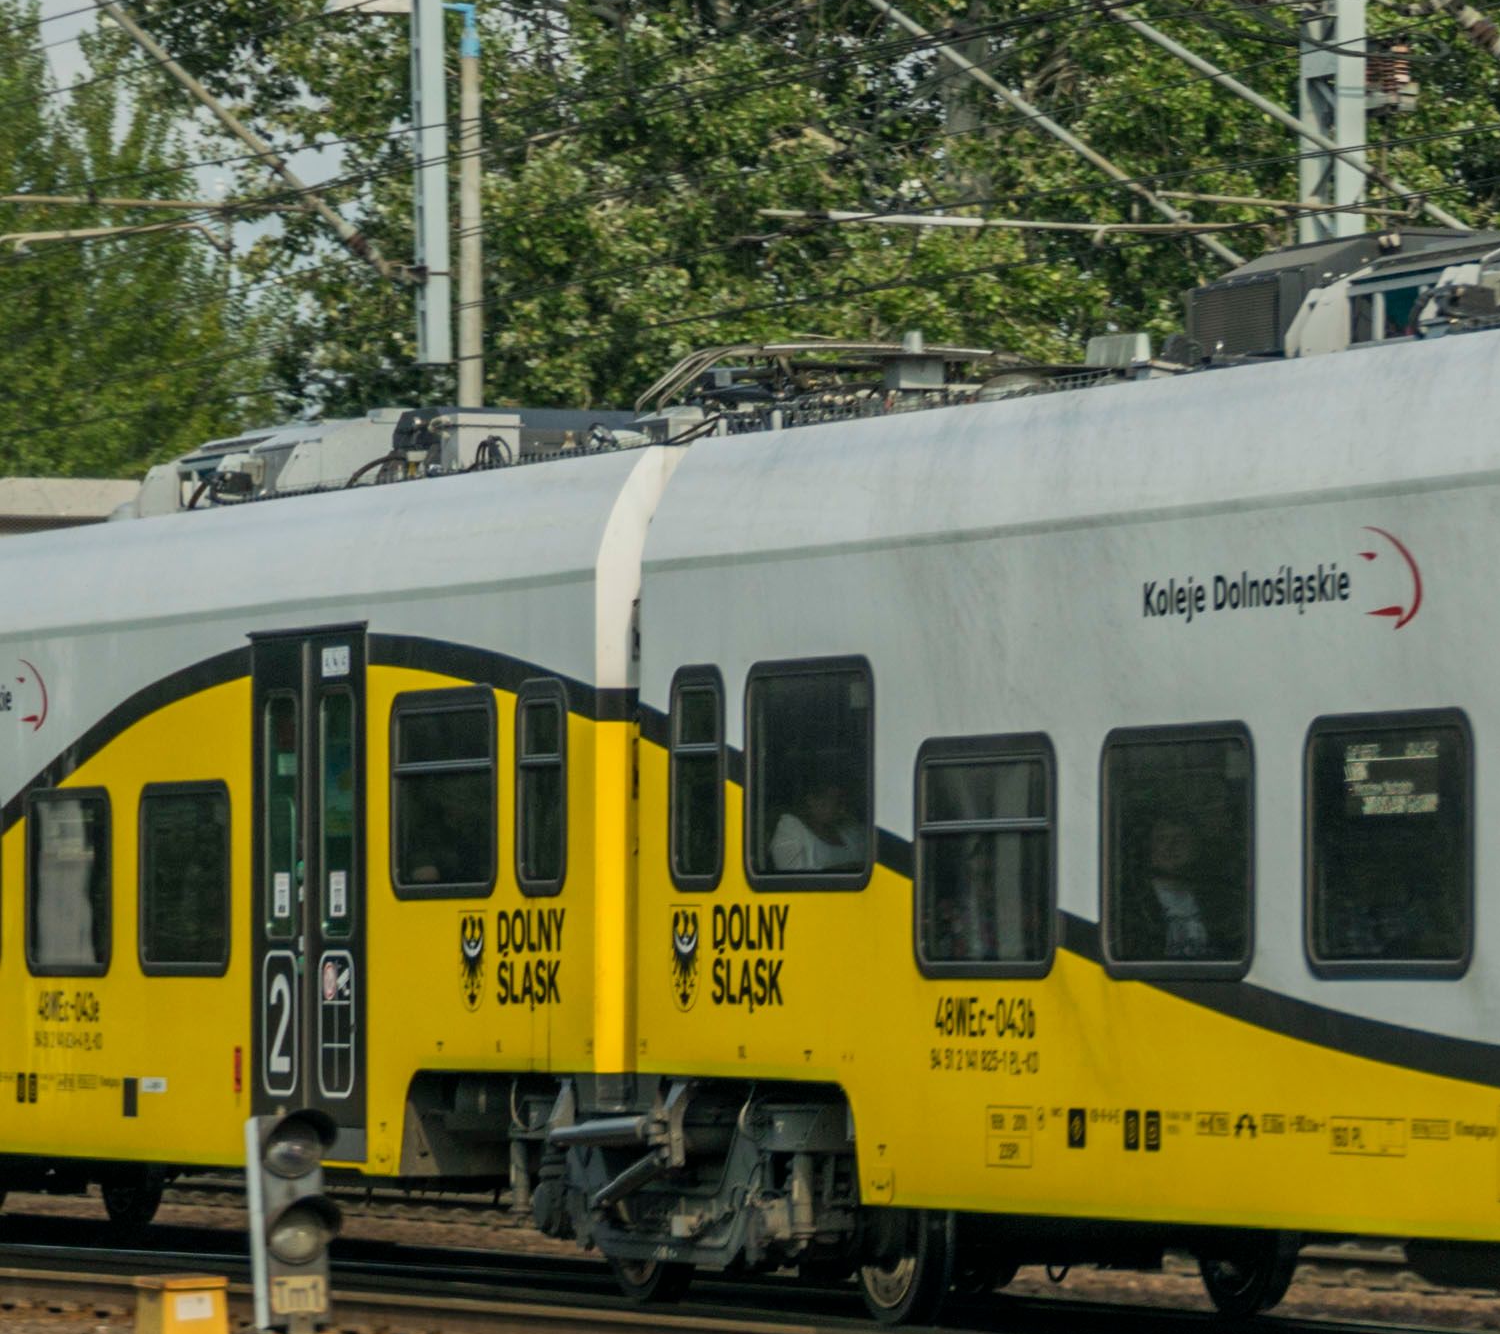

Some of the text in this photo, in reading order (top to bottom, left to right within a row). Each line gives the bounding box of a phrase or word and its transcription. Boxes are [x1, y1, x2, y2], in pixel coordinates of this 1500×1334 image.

[1143, 563, 1350, 623] Koleje Dolnośląskie
[497, 908, 566, 954] DOLNY
[712, 904, 789, 951] DOLNY
[496, 950, 561, 1012] ŚLĄSK
[711, 946, 784, 1014] ŚLĄSK
[269, 973, 291, 1074] 2
[934, 996, 1036, 1039] 48WEc-043b
